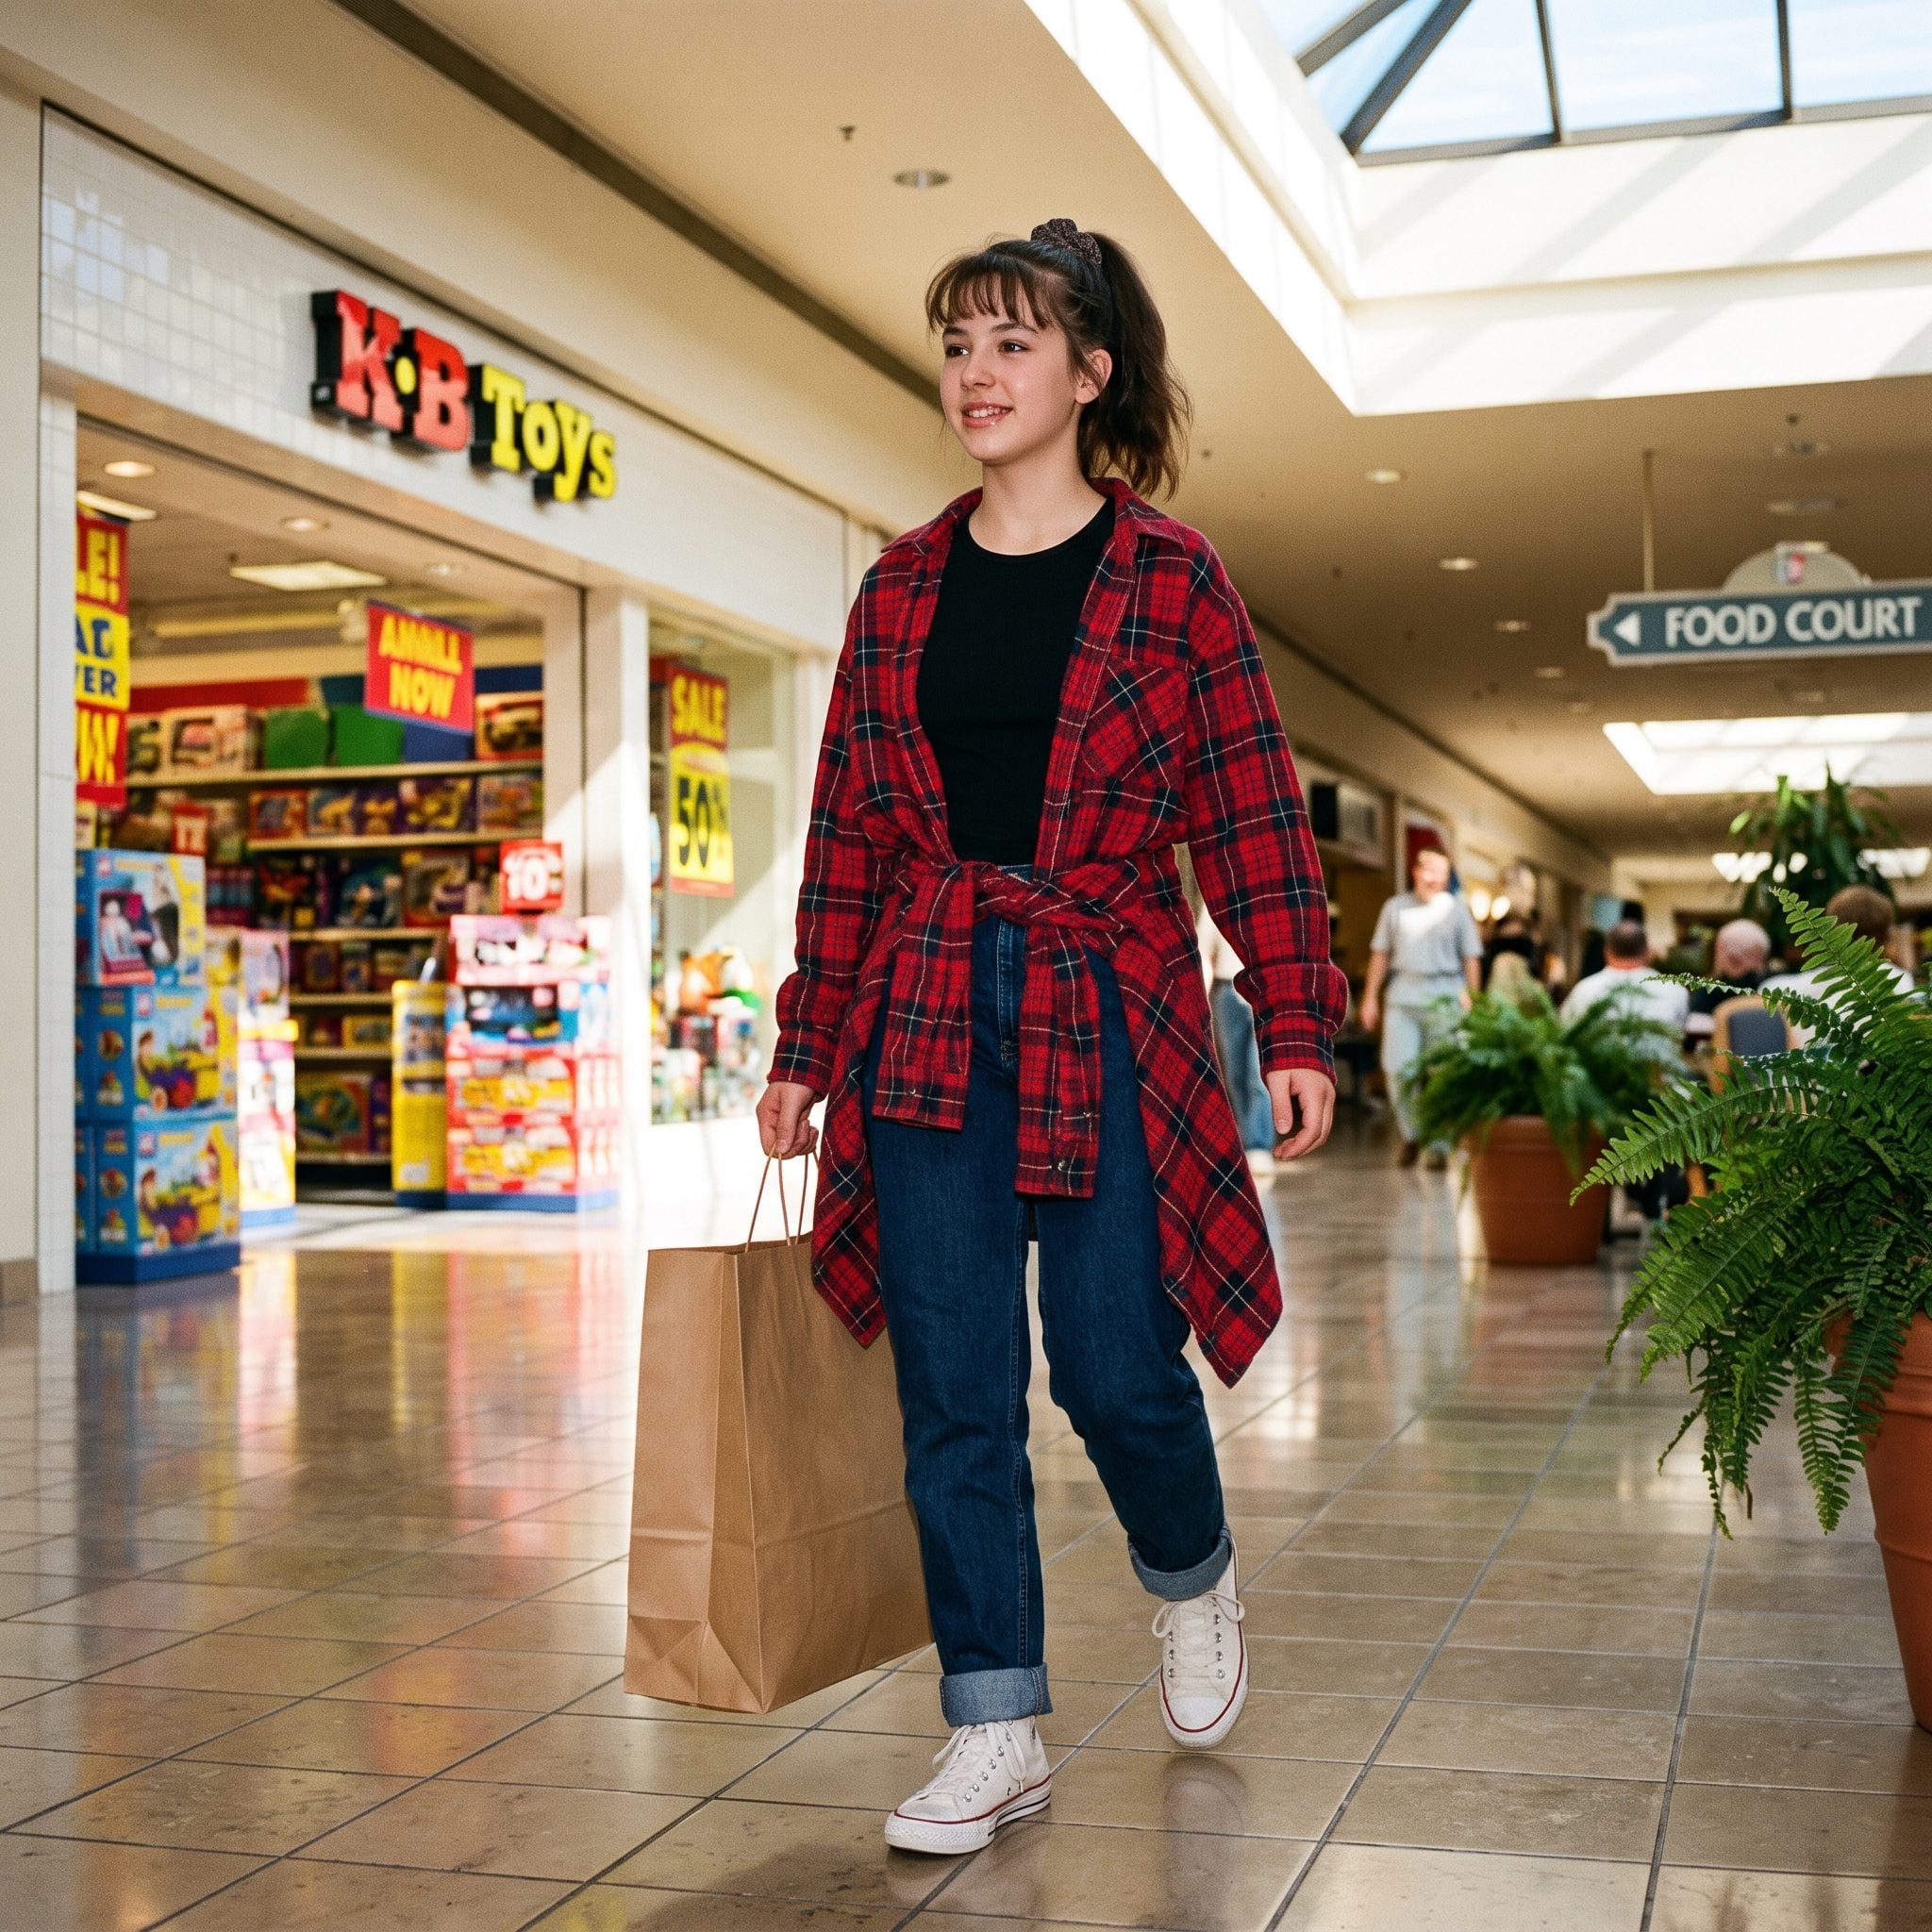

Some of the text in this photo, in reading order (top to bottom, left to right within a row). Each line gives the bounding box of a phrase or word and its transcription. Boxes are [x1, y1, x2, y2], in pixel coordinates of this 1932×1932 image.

[482, 363, 617, 502] Toys
[1665, 596, 1923, 648] FOOD COURT
[390, 661, 456, 719] NOW
[672, 675, 725, 742] SALE
